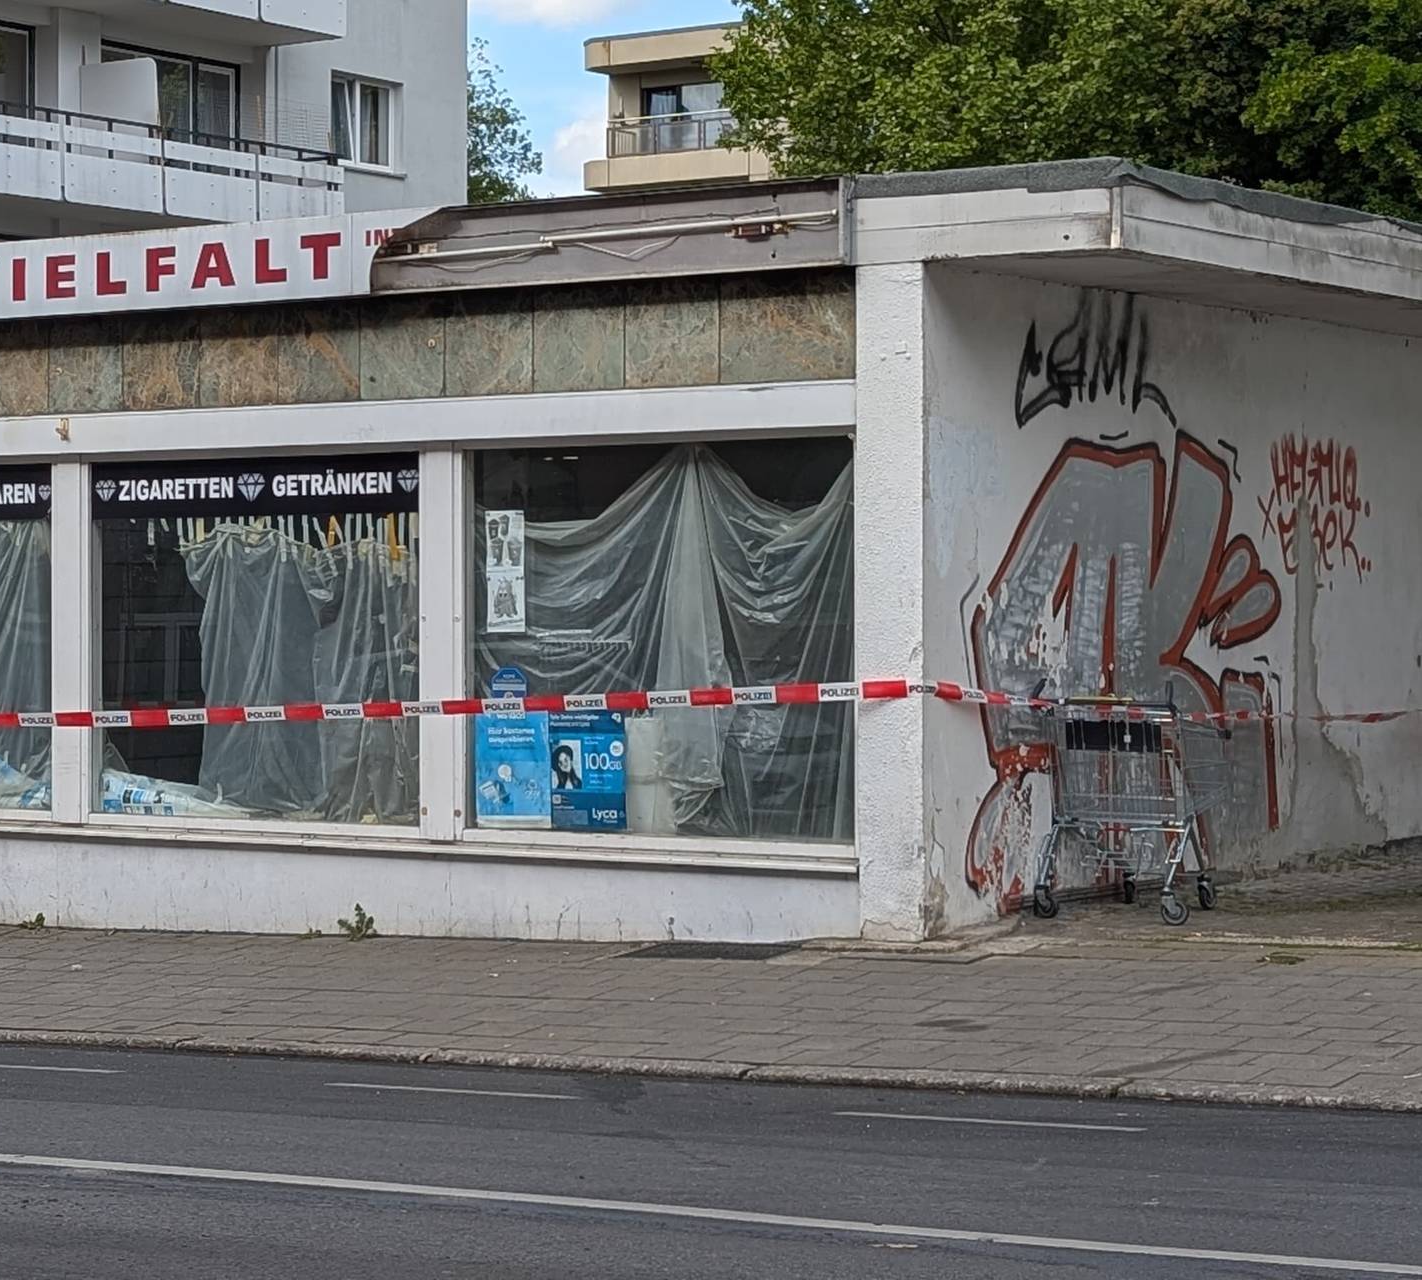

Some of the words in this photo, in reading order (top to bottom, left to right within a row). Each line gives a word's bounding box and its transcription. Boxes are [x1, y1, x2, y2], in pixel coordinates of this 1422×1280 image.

[118, 476, 234, 502] ZIGARETTEN
[272, 470, 392, 497] GETRÄNKEN
[735, 690, 773, 701] POLIZEI
[820, 686, 859, 698] POLIZEI
[566, 699, 604, 708] POLIZEI
[650, 695, 687, 705] POLIZEI
[404, 705, 440, 714] POLIZEI
[485, 702, 521, 711] POLIZEI
[247, 710, 282, 719] POLIZEI
[325, 708, 361, 717] POLIZEI
[21, 716, 53, 724] POLIZEI
[94, 715, 128, 724] POLIZEI
[170, 713, 205, 722] POLIZEI
[592, 807, 618, 821] Lyca
